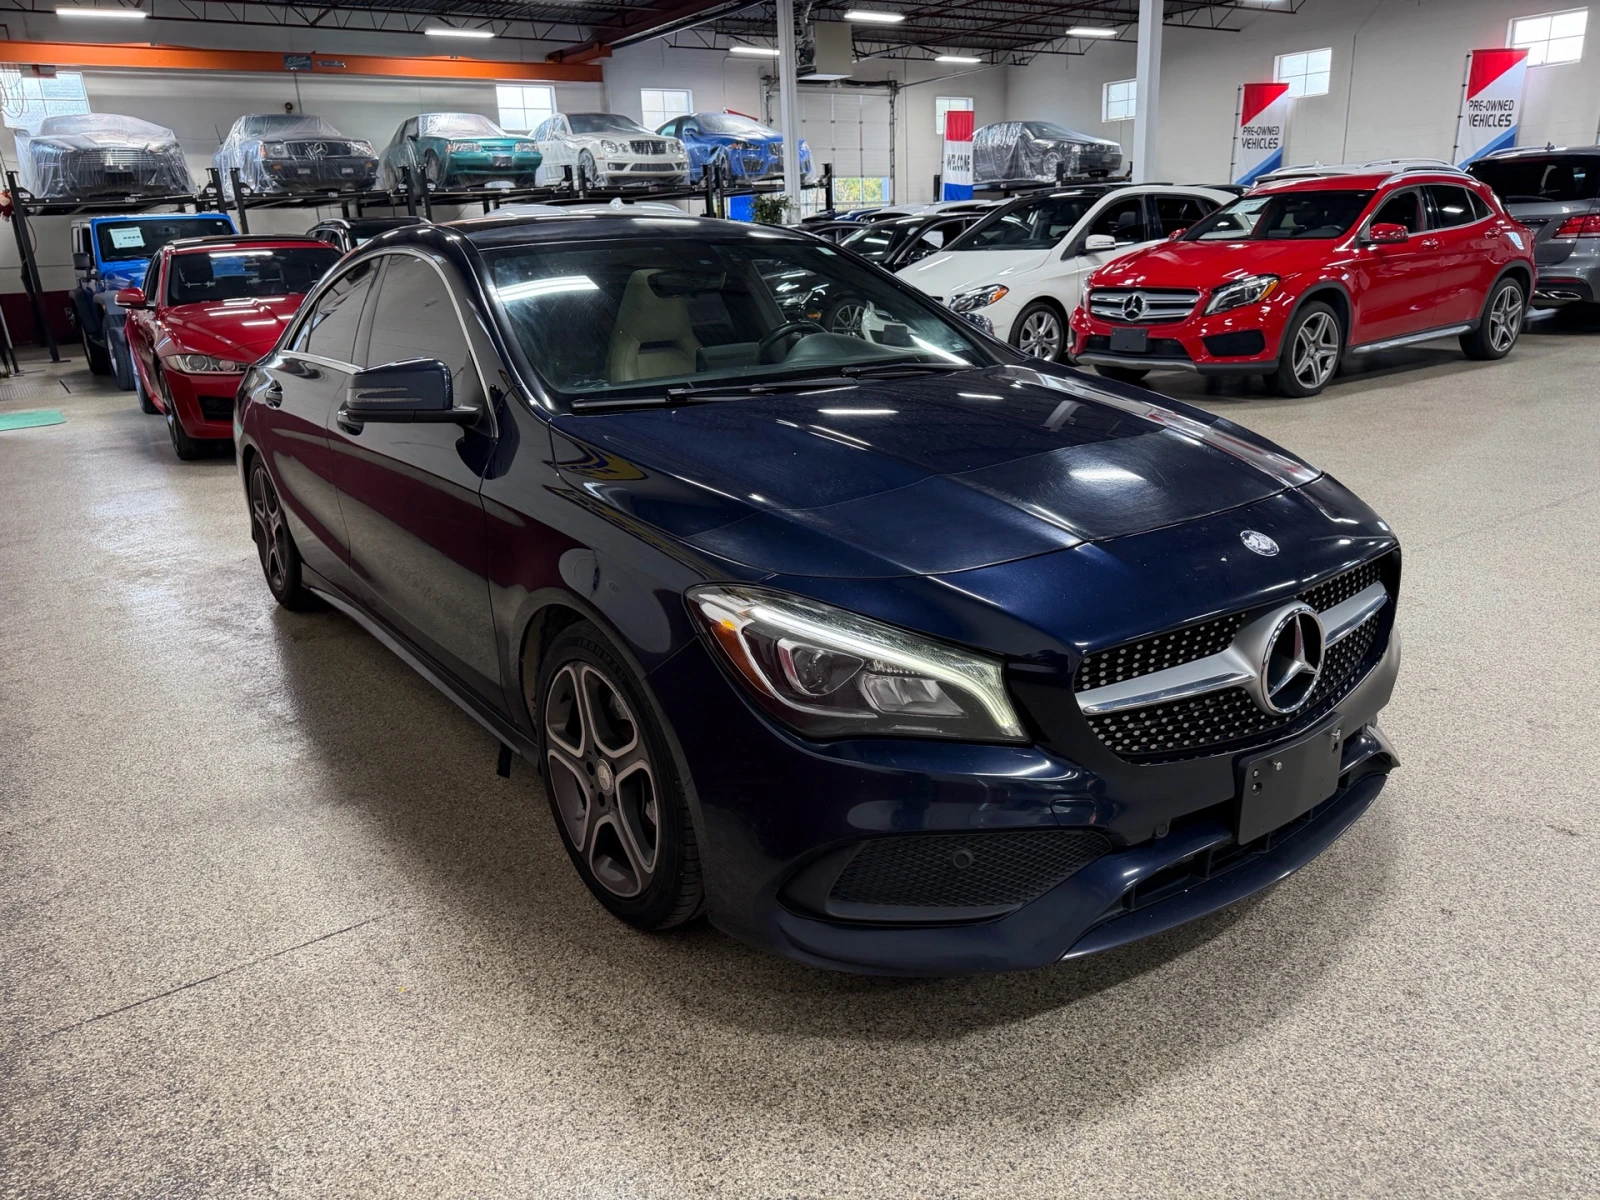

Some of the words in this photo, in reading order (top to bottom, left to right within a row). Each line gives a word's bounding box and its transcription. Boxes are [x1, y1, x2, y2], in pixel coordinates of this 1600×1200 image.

[1468, 99, 1515, 112] PRE-OWNED
[1467, 113, 1513, 128] VEHICLES
[1242, 126, 1280, 136] PRE-OWNED
[1241, 137, 1279, 149] VEHICLES
[578, 637, 626, 682] IRONMAN
